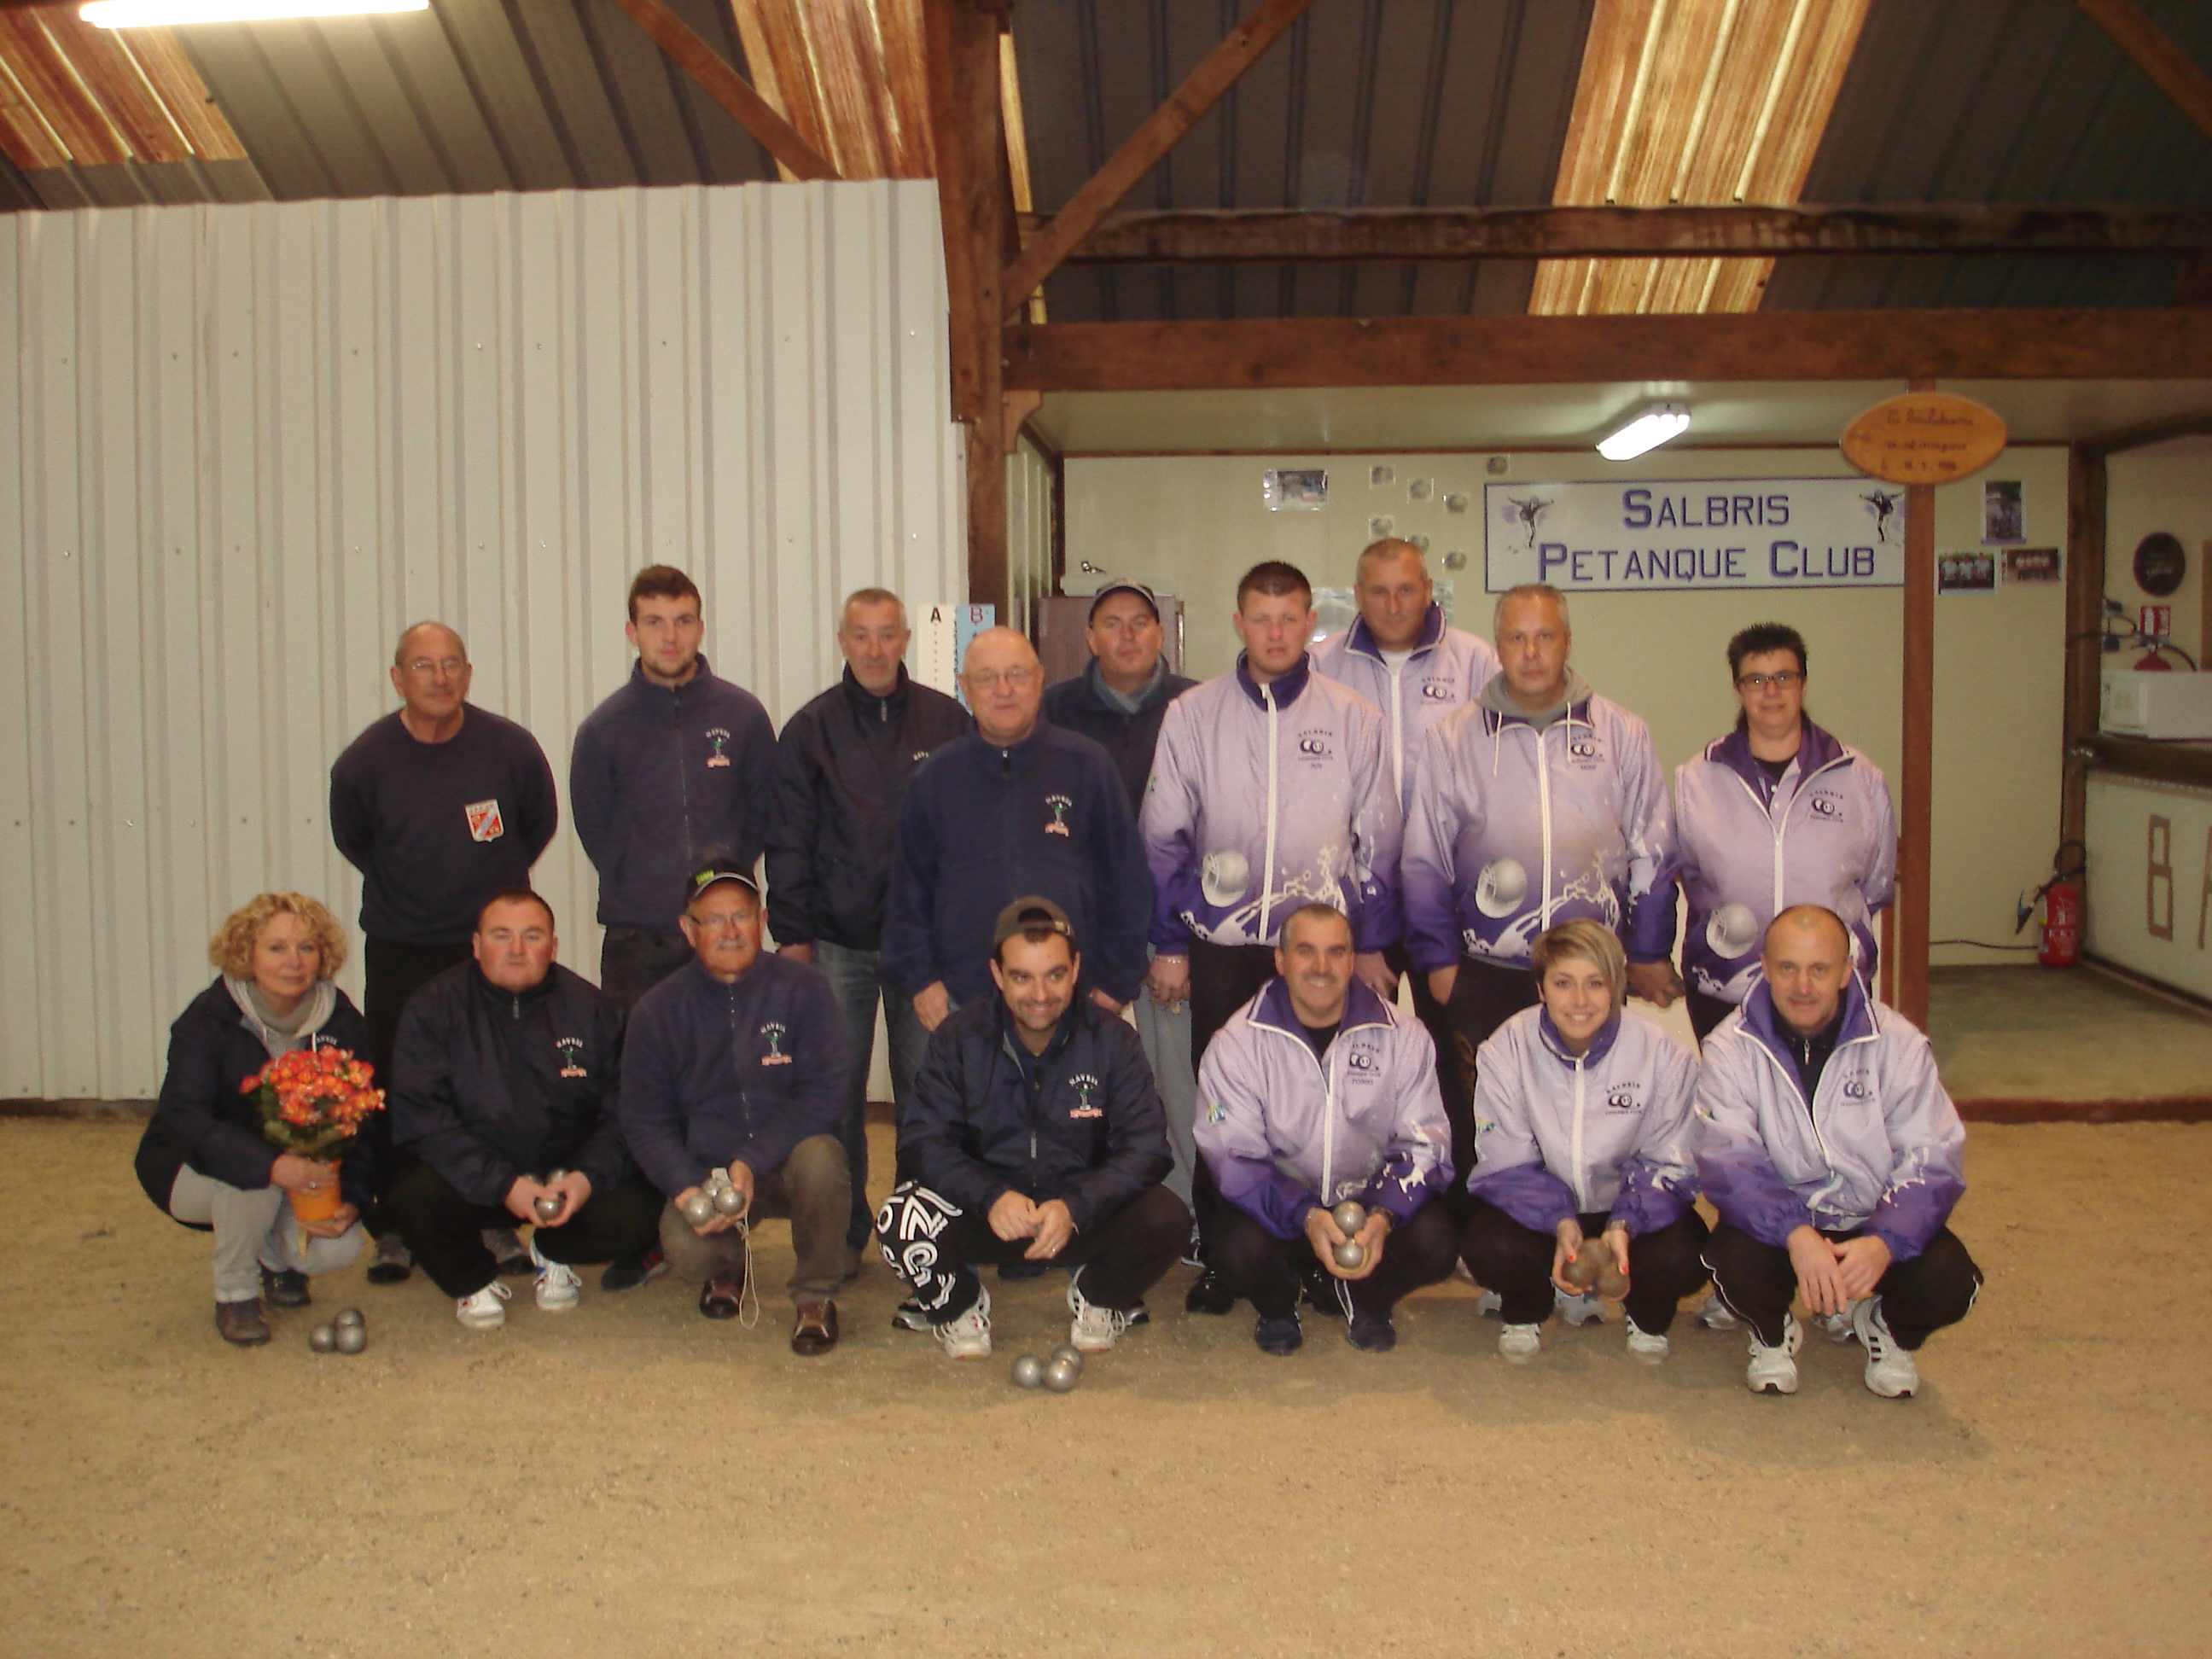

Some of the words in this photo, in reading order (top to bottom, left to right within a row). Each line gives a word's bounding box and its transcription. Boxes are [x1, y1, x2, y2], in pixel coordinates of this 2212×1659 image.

[1623, 490, 1790, 528] SALBRIS
[1539, 542, 1747, 582] PETANQUE
[1769, 540, 1875, 579] CLUB
[930, 607, 941, 623] A
[970, 604, 983, 623] B
